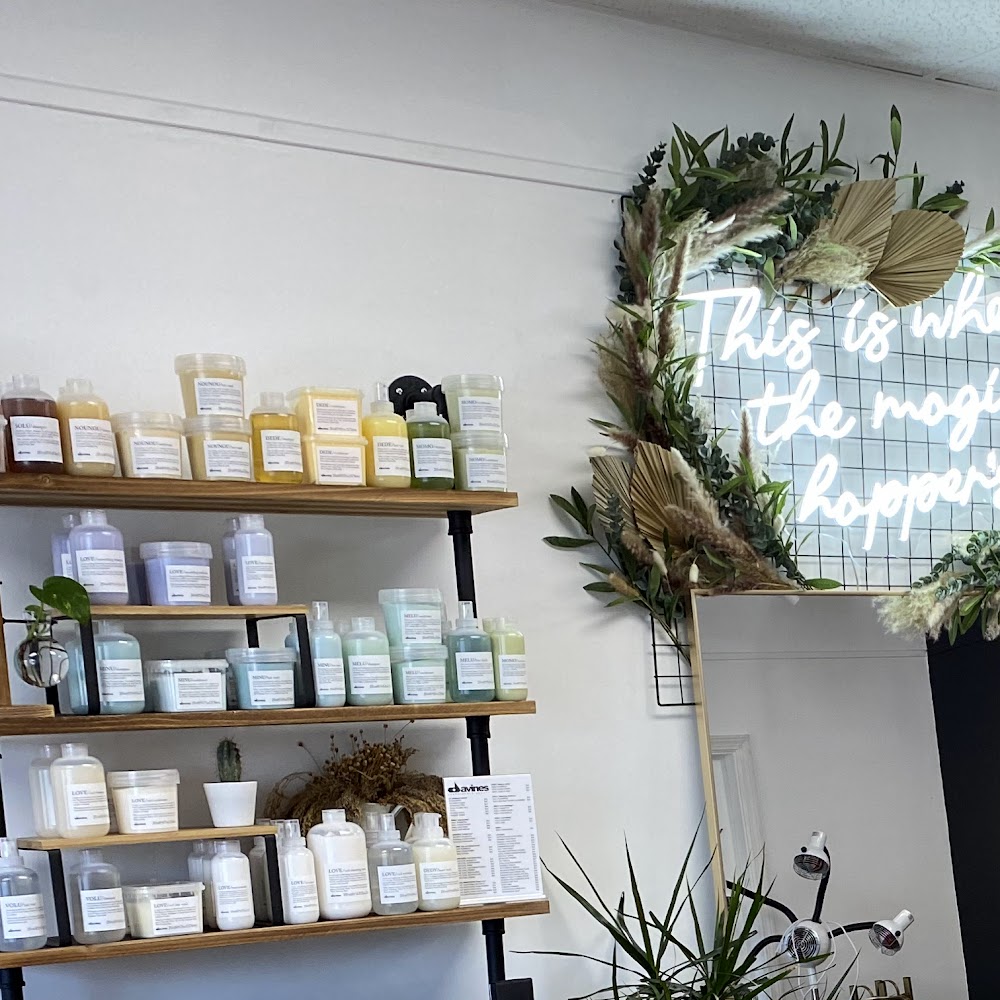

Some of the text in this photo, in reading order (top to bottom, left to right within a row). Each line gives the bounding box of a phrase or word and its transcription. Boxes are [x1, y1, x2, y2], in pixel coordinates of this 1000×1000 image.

[678, 285, 820, 378] This
[842, 298, 898, 364] is
[747, 369, 856, 447] the
